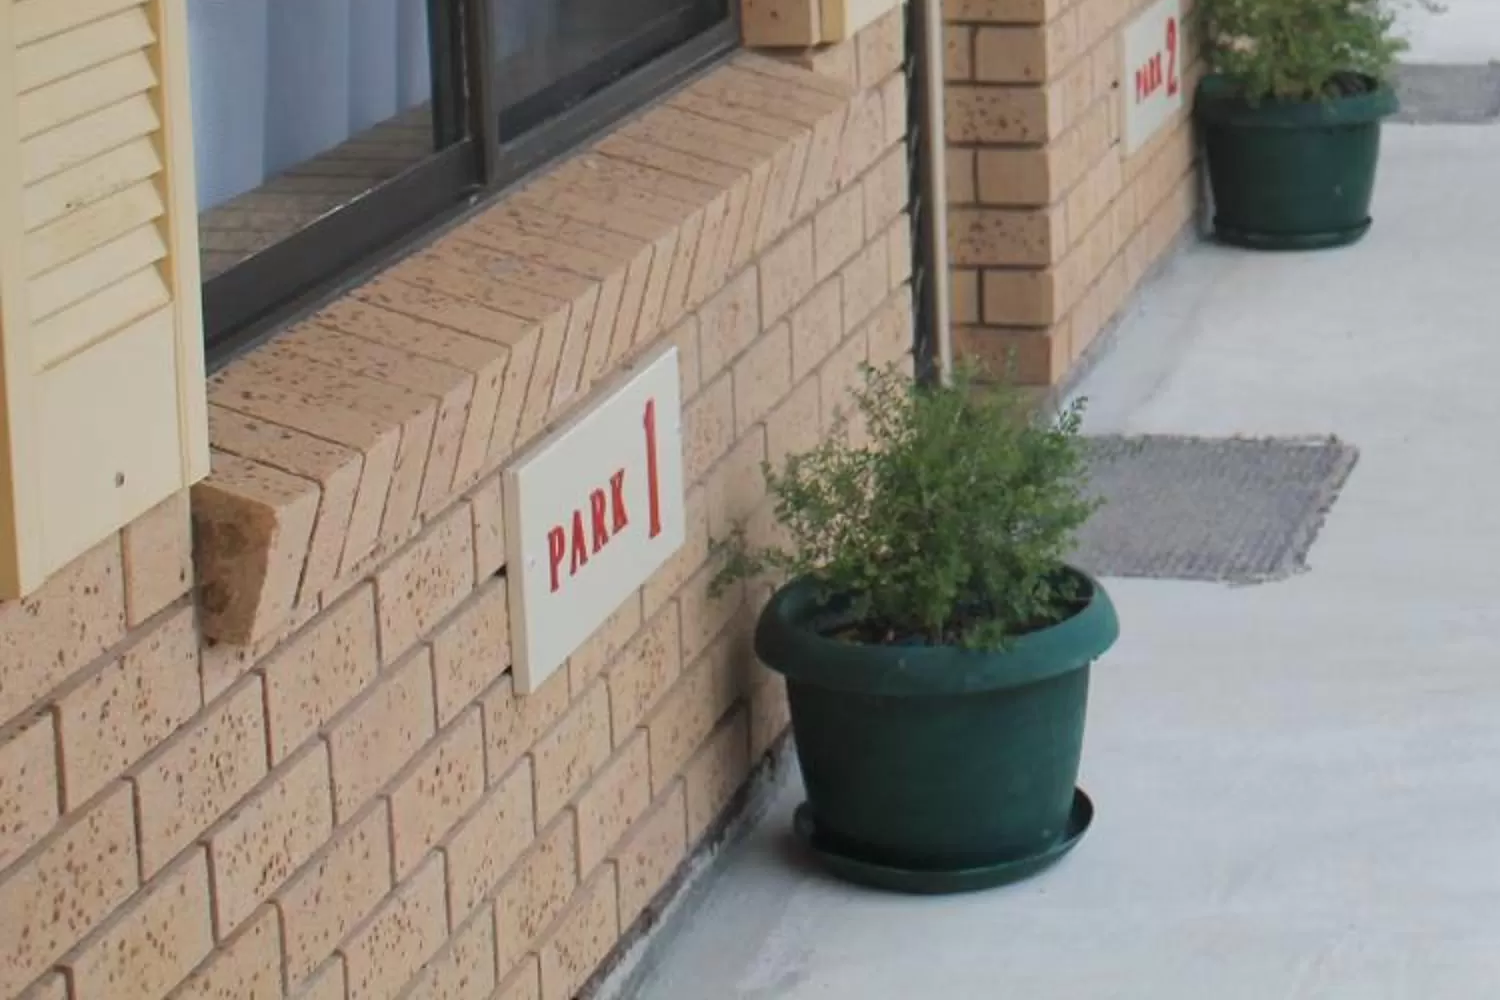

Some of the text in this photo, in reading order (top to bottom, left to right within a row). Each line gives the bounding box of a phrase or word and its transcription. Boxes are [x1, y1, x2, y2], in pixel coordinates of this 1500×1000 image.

[1167, 17, 1178, 97] 2
[547, 397, 661, 593] PARK 1
